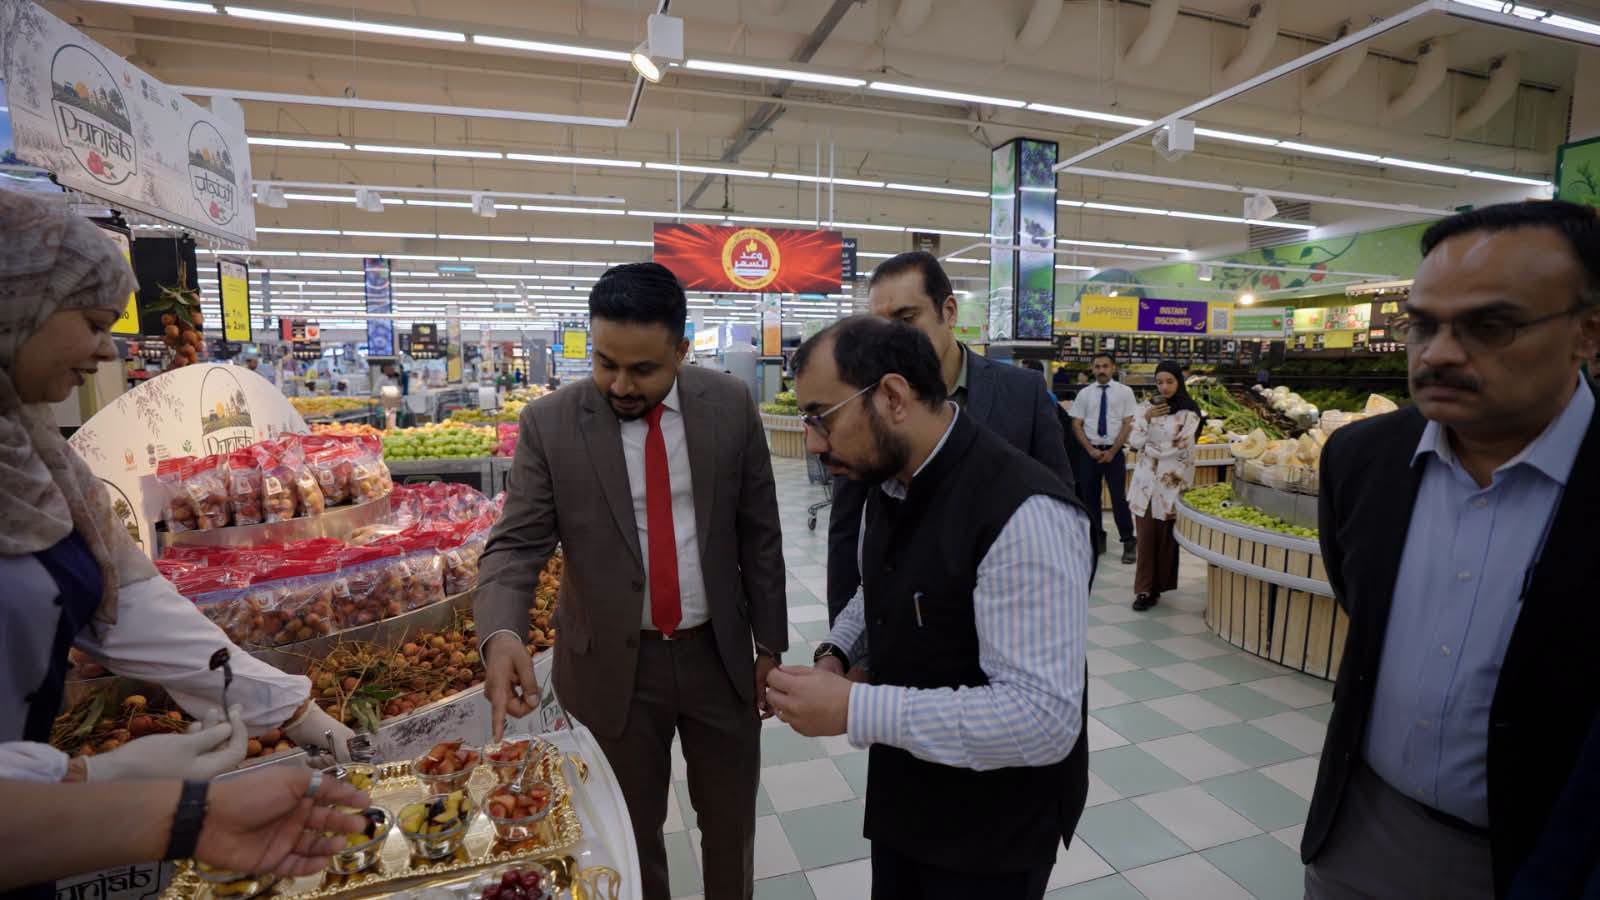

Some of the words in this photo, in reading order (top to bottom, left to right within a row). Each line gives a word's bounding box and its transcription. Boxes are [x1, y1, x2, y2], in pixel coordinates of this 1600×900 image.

[59, 105, 132, 162] Punjab
[1154, 317, 1192, 326] DISCOUNTS
[1159, 306, 1188, 316] INSTANT
[56, 864, 153, 900] unjab
